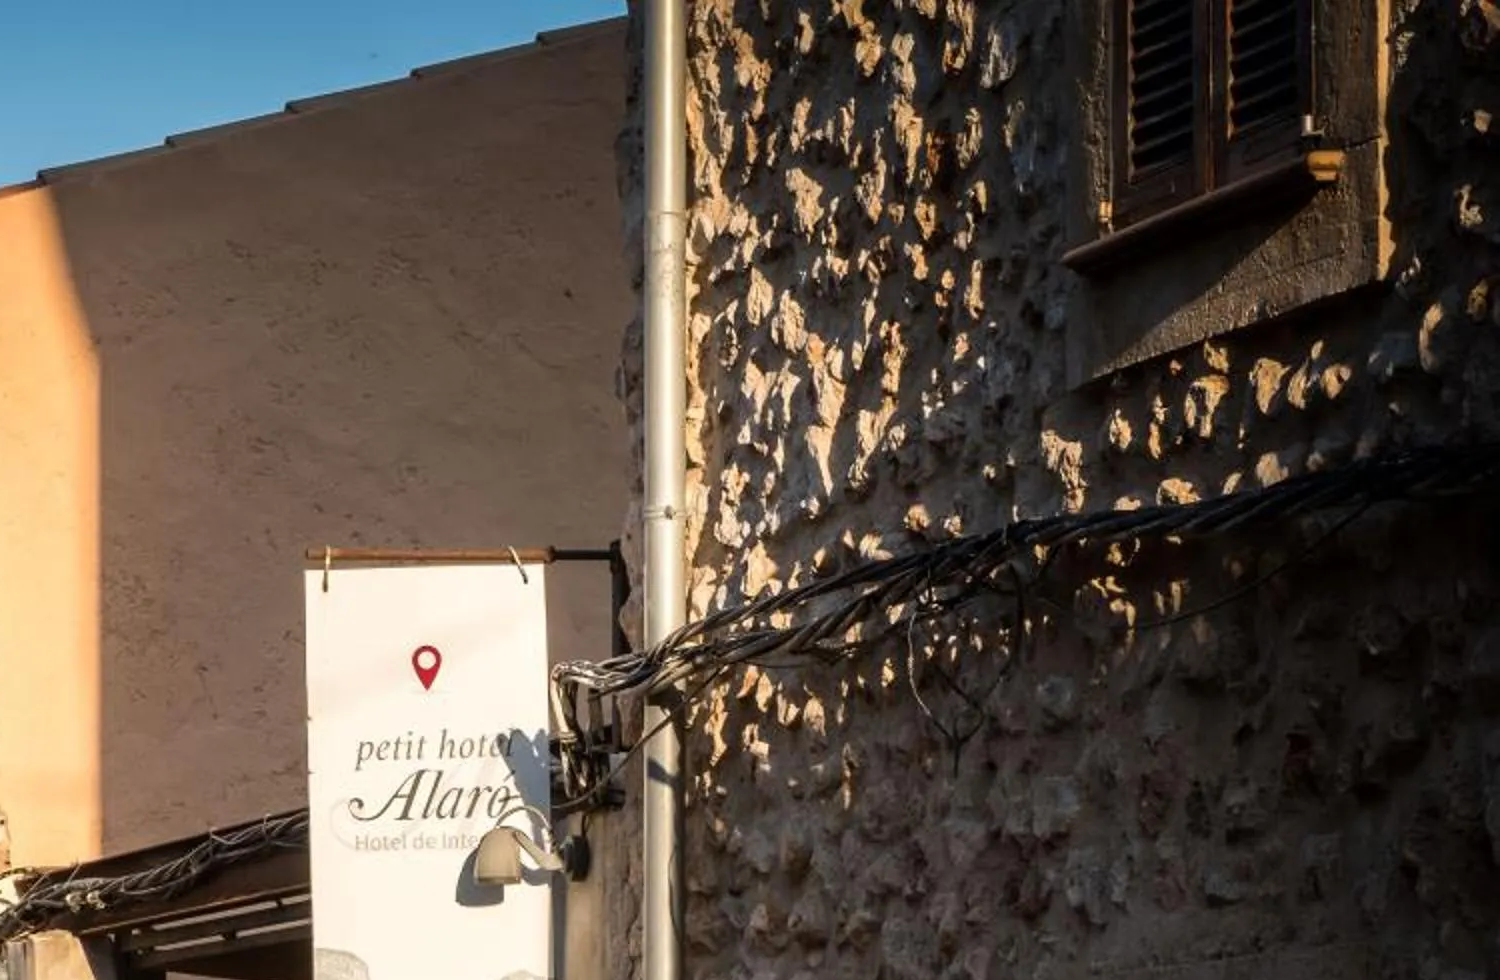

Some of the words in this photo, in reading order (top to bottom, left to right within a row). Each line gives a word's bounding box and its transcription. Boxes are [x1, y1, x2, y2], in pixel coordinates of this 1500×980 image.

[355, 730, 427, 771] petit
[439, 728, 514, 761] hotel
[347, 768, 522, 821] Alaró
[355, 832, 407, 852] Hotel
[412, 832, 437, 850] de
